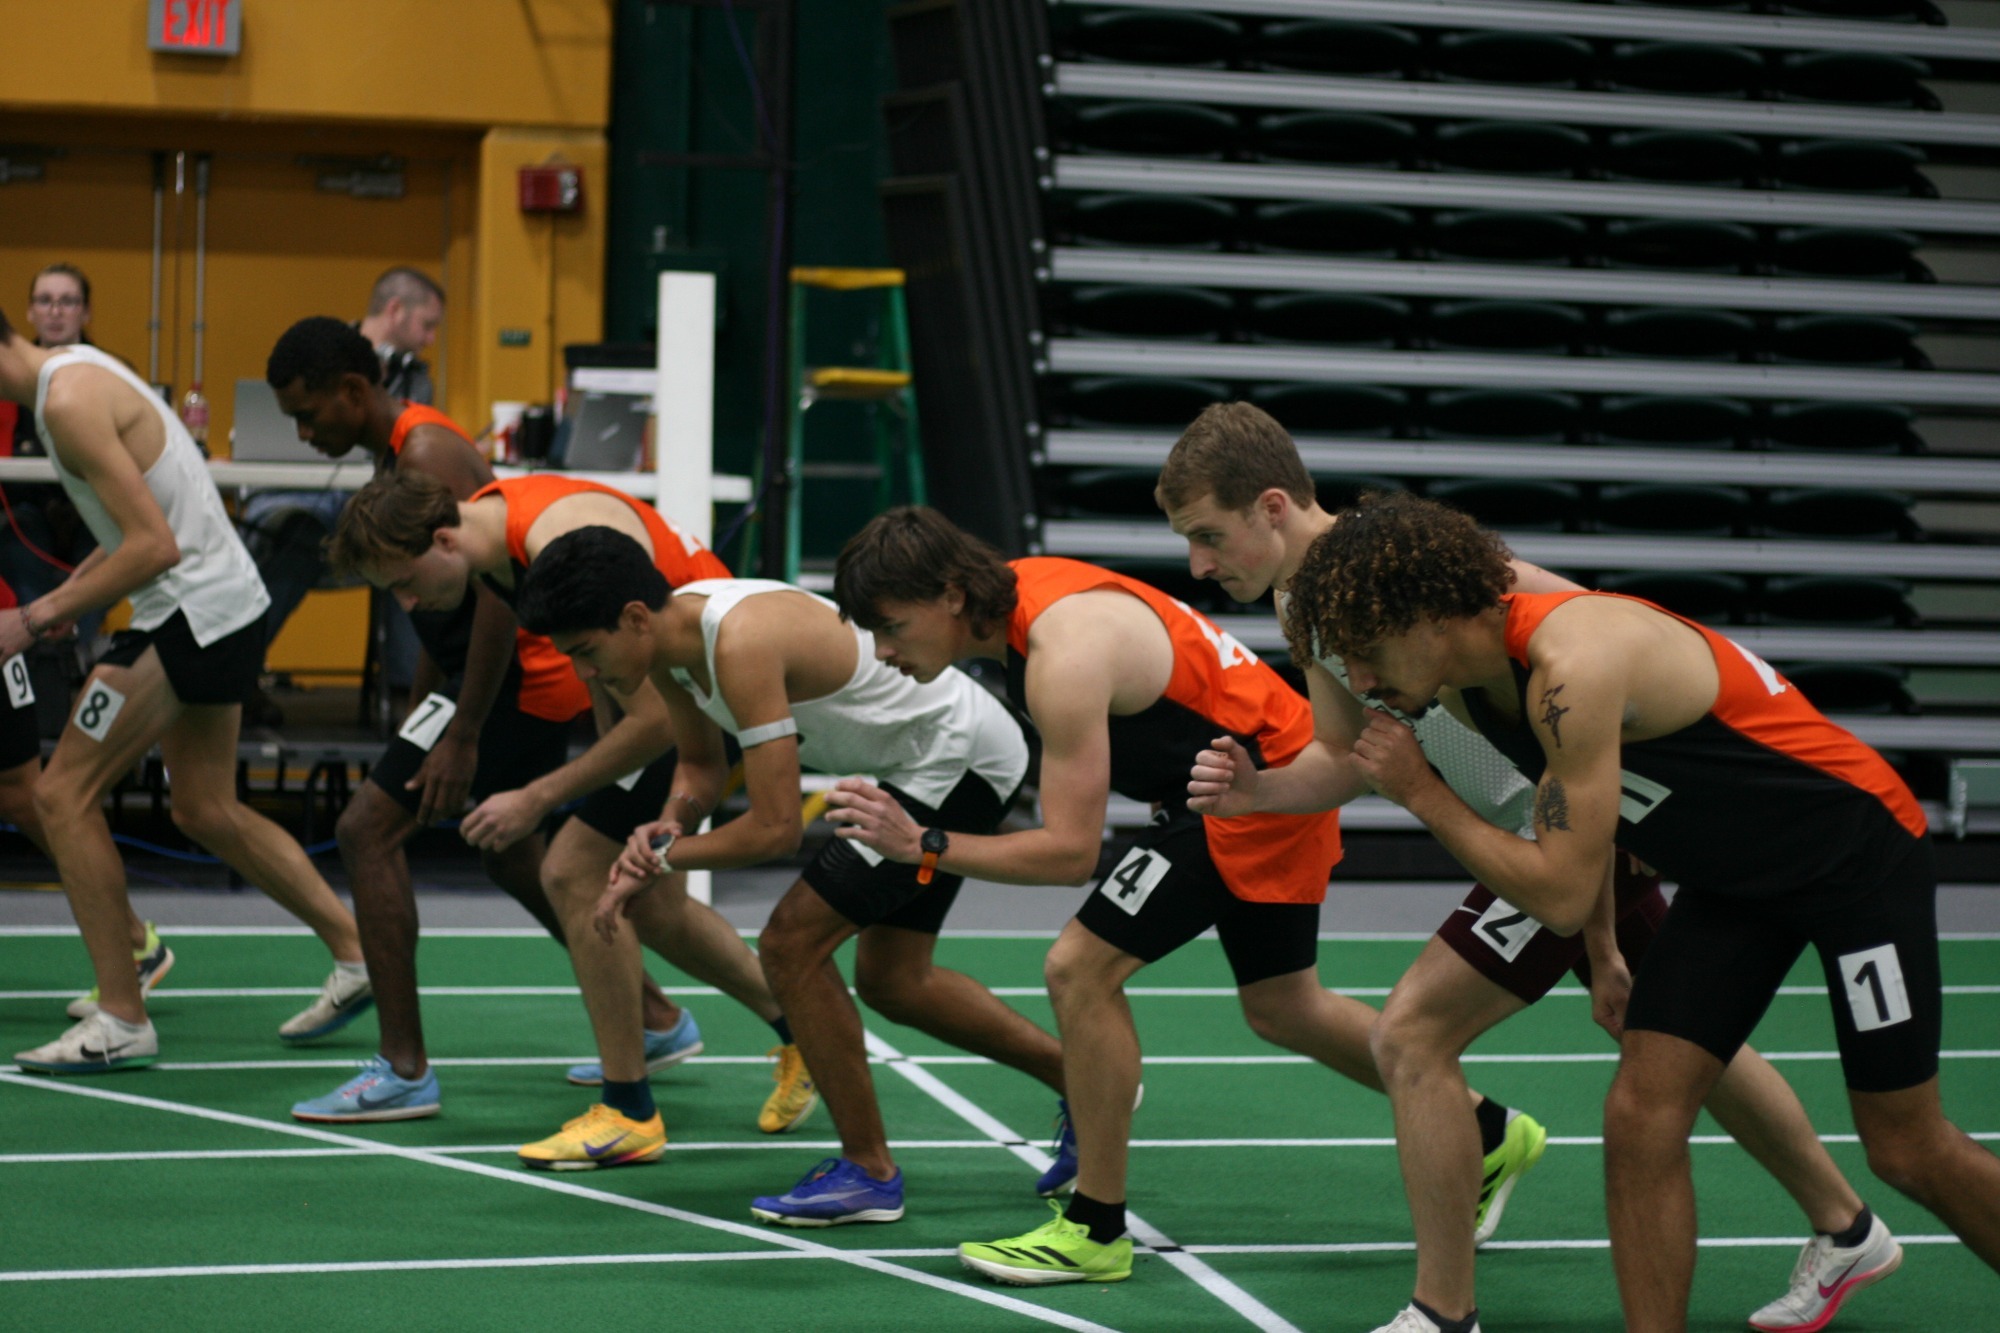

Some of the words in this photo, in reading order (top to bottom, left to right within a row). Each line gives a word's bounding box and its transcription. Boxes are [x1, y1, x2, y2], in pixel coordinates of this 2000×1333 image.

[163, 0, 229, 48] EXIT
[11, 661, 28, 700] 9
[80, 690, 109, 730] 8
[408, 700, 443, 734] 7
[1113, 853, 1153, 900] 4
[1481, 912, 1529, 948] 2
[1853, 960, 1890, 1022] 1
